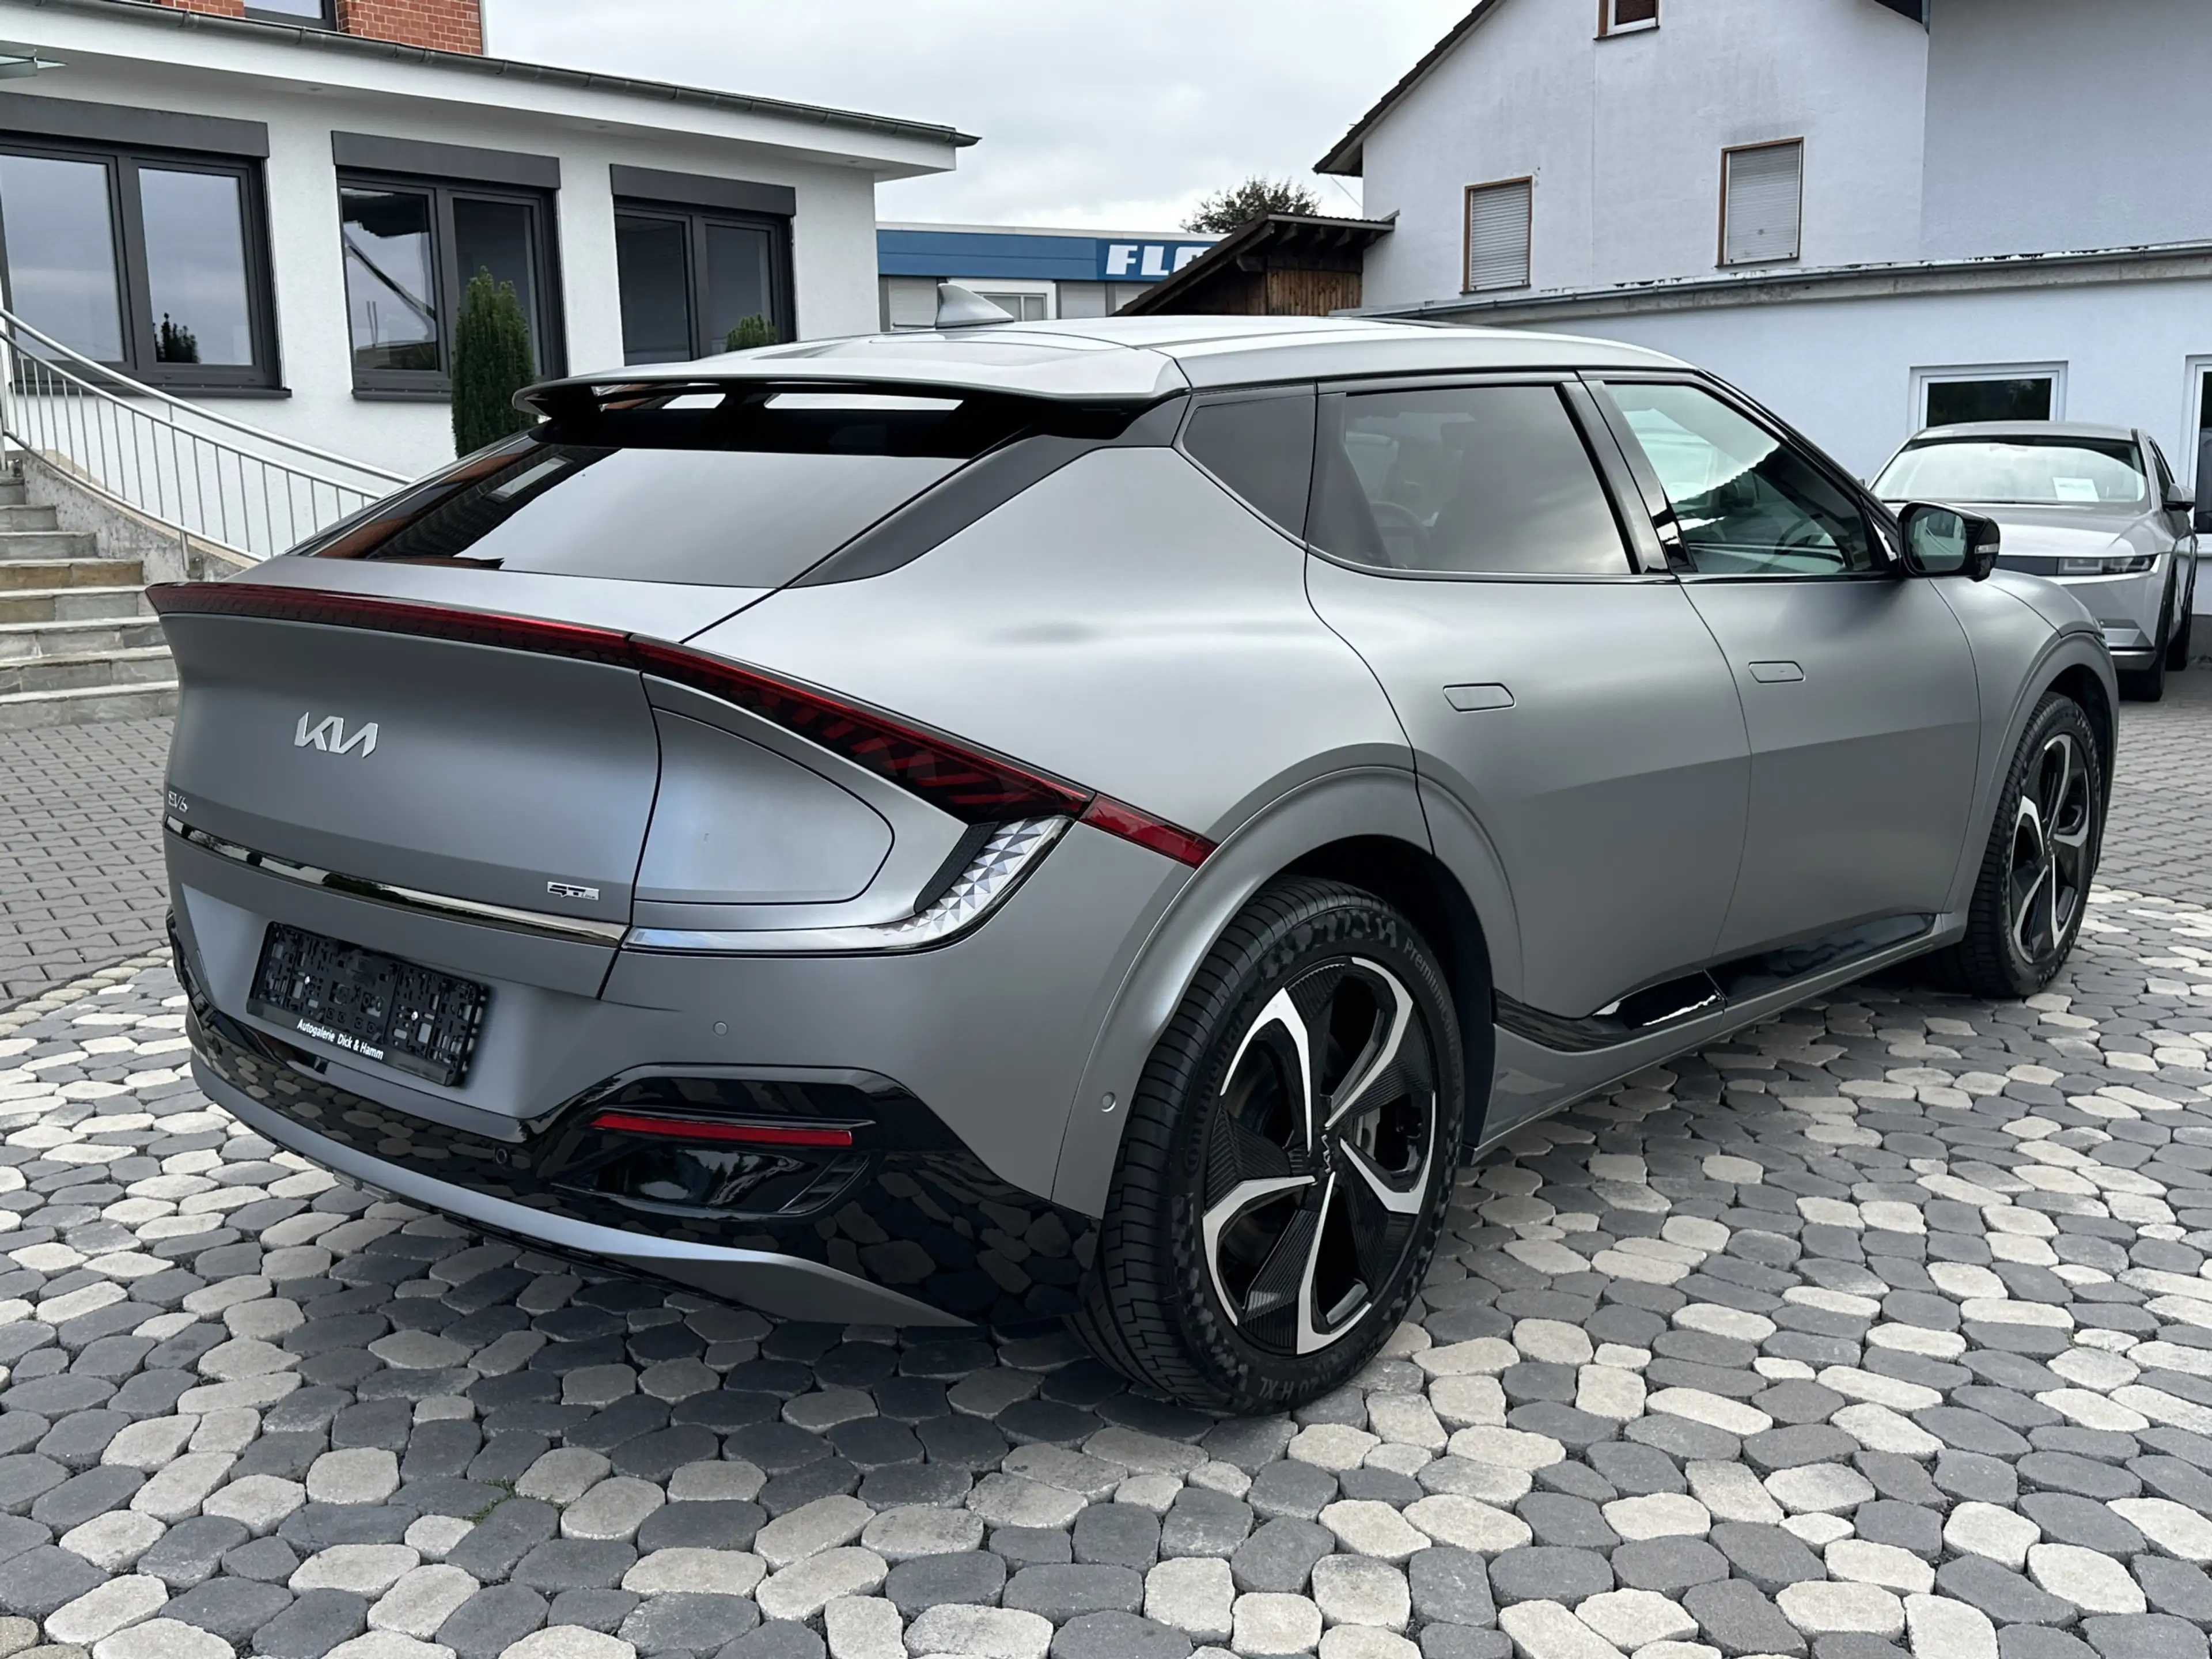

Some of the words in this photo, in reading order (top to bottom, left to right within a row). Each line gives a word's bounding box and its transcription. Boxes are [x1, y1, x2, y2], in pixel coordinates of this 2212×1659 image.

[294, 711, 378, 758] KIA
[168, 790, 188, 813] EV6
[297, 1018, 335, 1042] Autogalerie
[337, 1033, 353, 1050] Dick
[353, 1039, 359, 1052] &
[359, 1041, 384, 1060] Hamm
